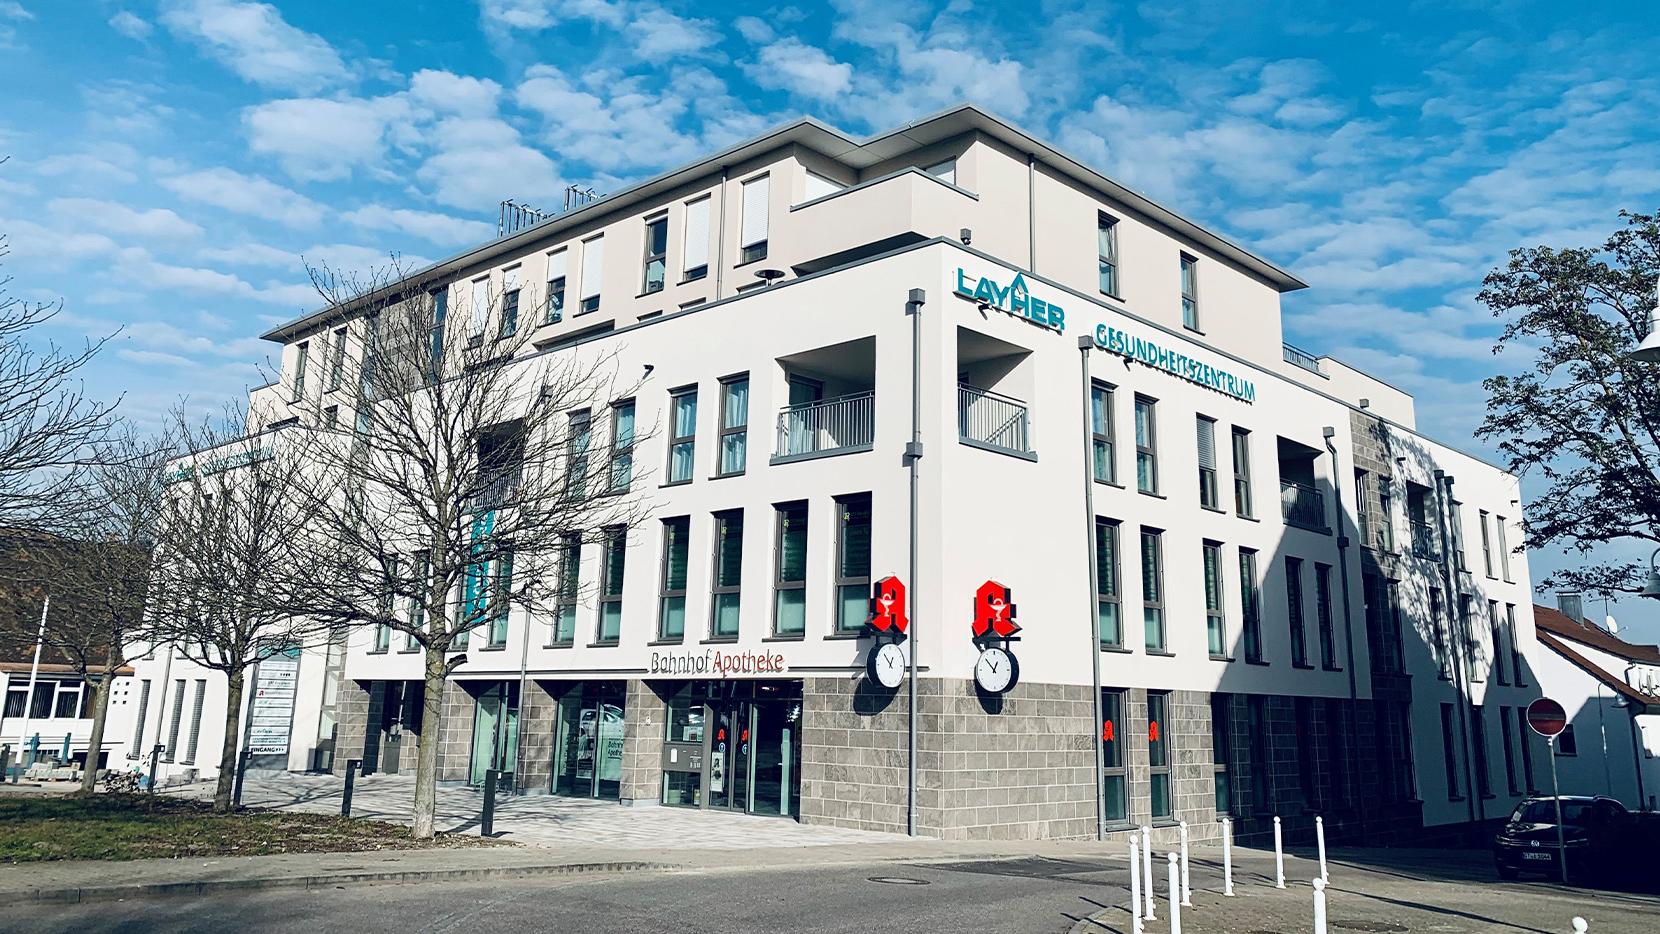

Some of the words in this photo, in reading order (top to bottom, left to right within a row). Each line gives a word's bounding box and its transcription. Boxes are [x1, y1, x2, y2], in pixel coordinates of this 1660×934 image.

[957, 268, 1065, 332] LAYHER
[1095, 323, 1256, 404] GESUNDHEITSZENTRUM
[651, 649, 712, 674] Bahnhof
[713, 649, 784, 678] Apotheke
